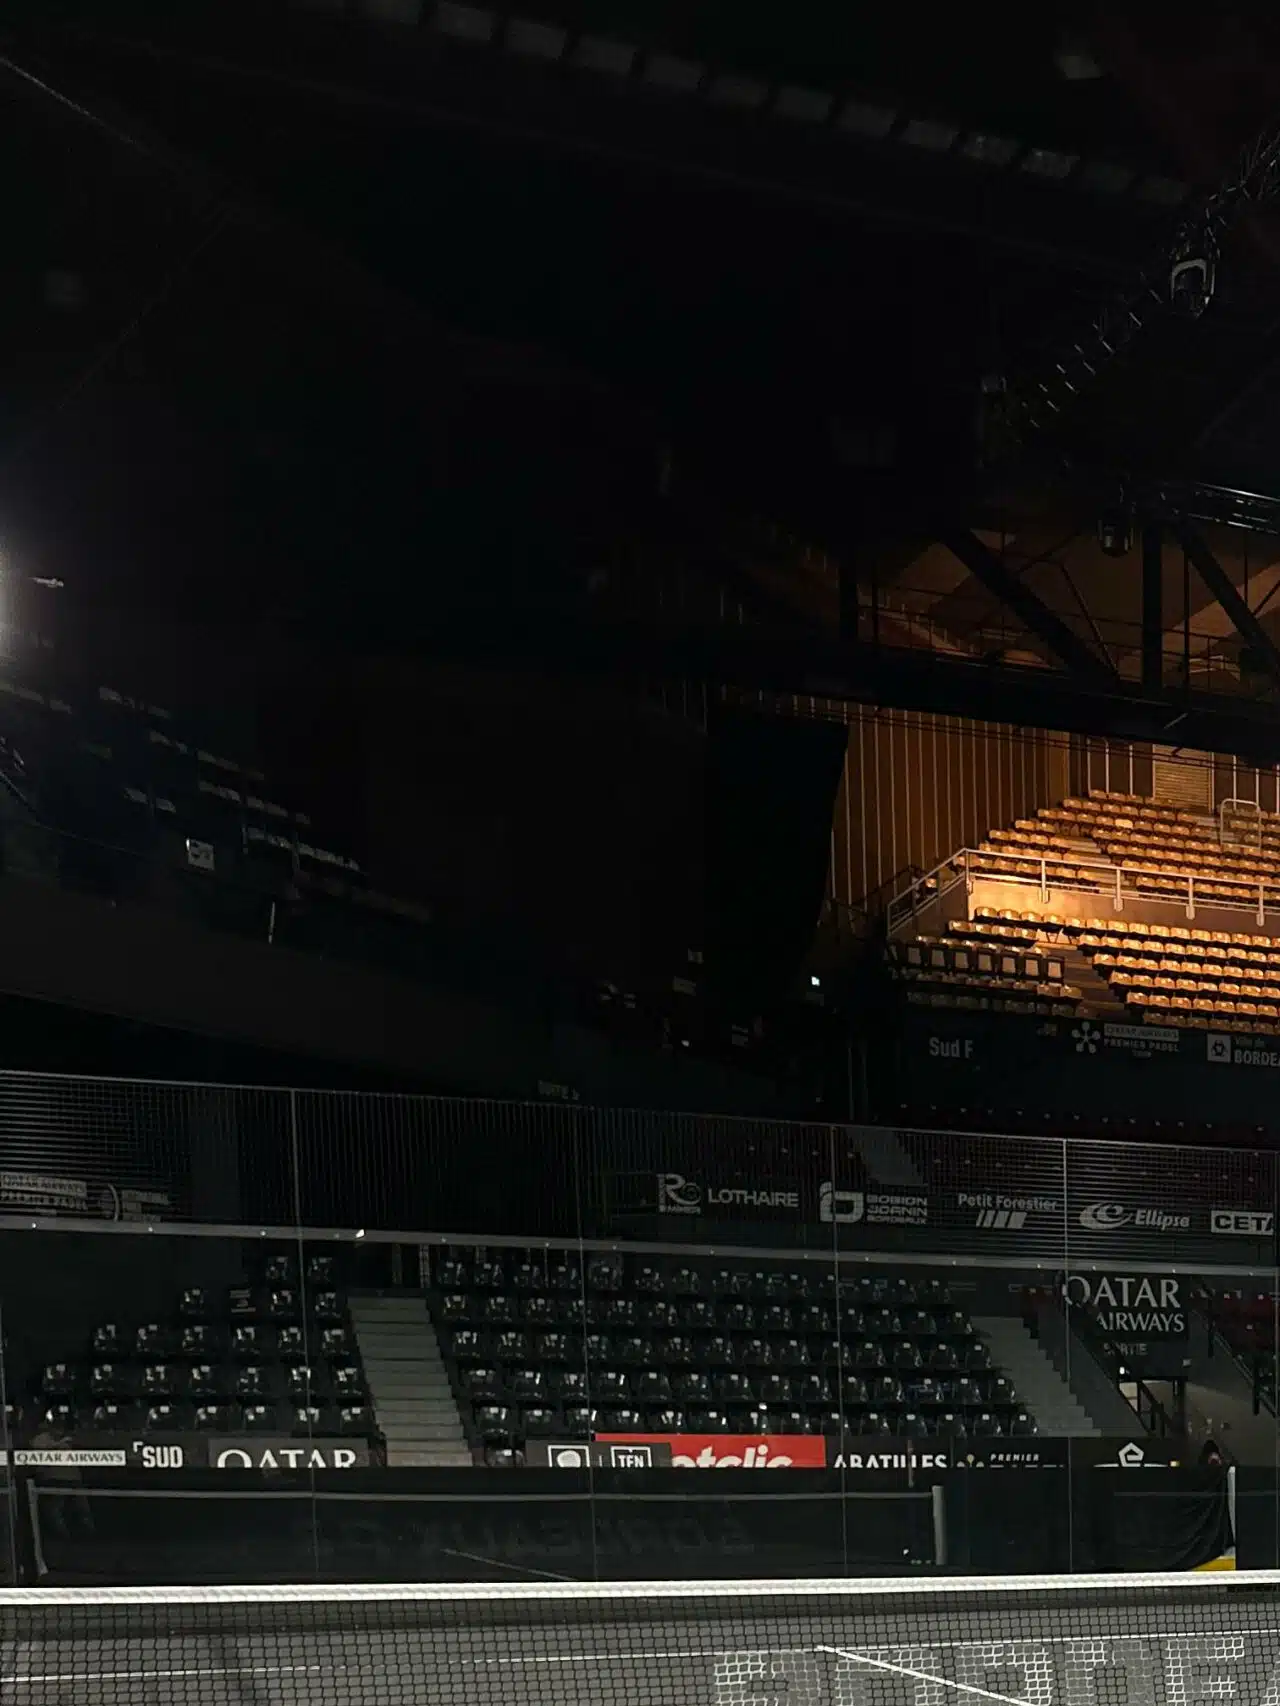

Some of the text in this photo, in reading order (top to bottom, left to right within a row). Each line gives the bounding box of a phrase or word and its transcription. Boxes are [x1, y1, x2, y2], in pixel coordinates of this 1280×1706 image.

[928, 1036, 960, 1058] Sud
[707, 1188, 799, 1208] LOTHAIRE
[958, 1193, 1059, 1213] Petit Forestier
[1135, 1209, 1190, 1231] Ellipse
[1062, 1275, 1181, 1309] QATAR
[1096, 1311, 1185, 1333] AIRWAYS
[16, 1452, 123, 1464] QATAR AIRWAYS
[143, 1445, 184, 1468] SUD
